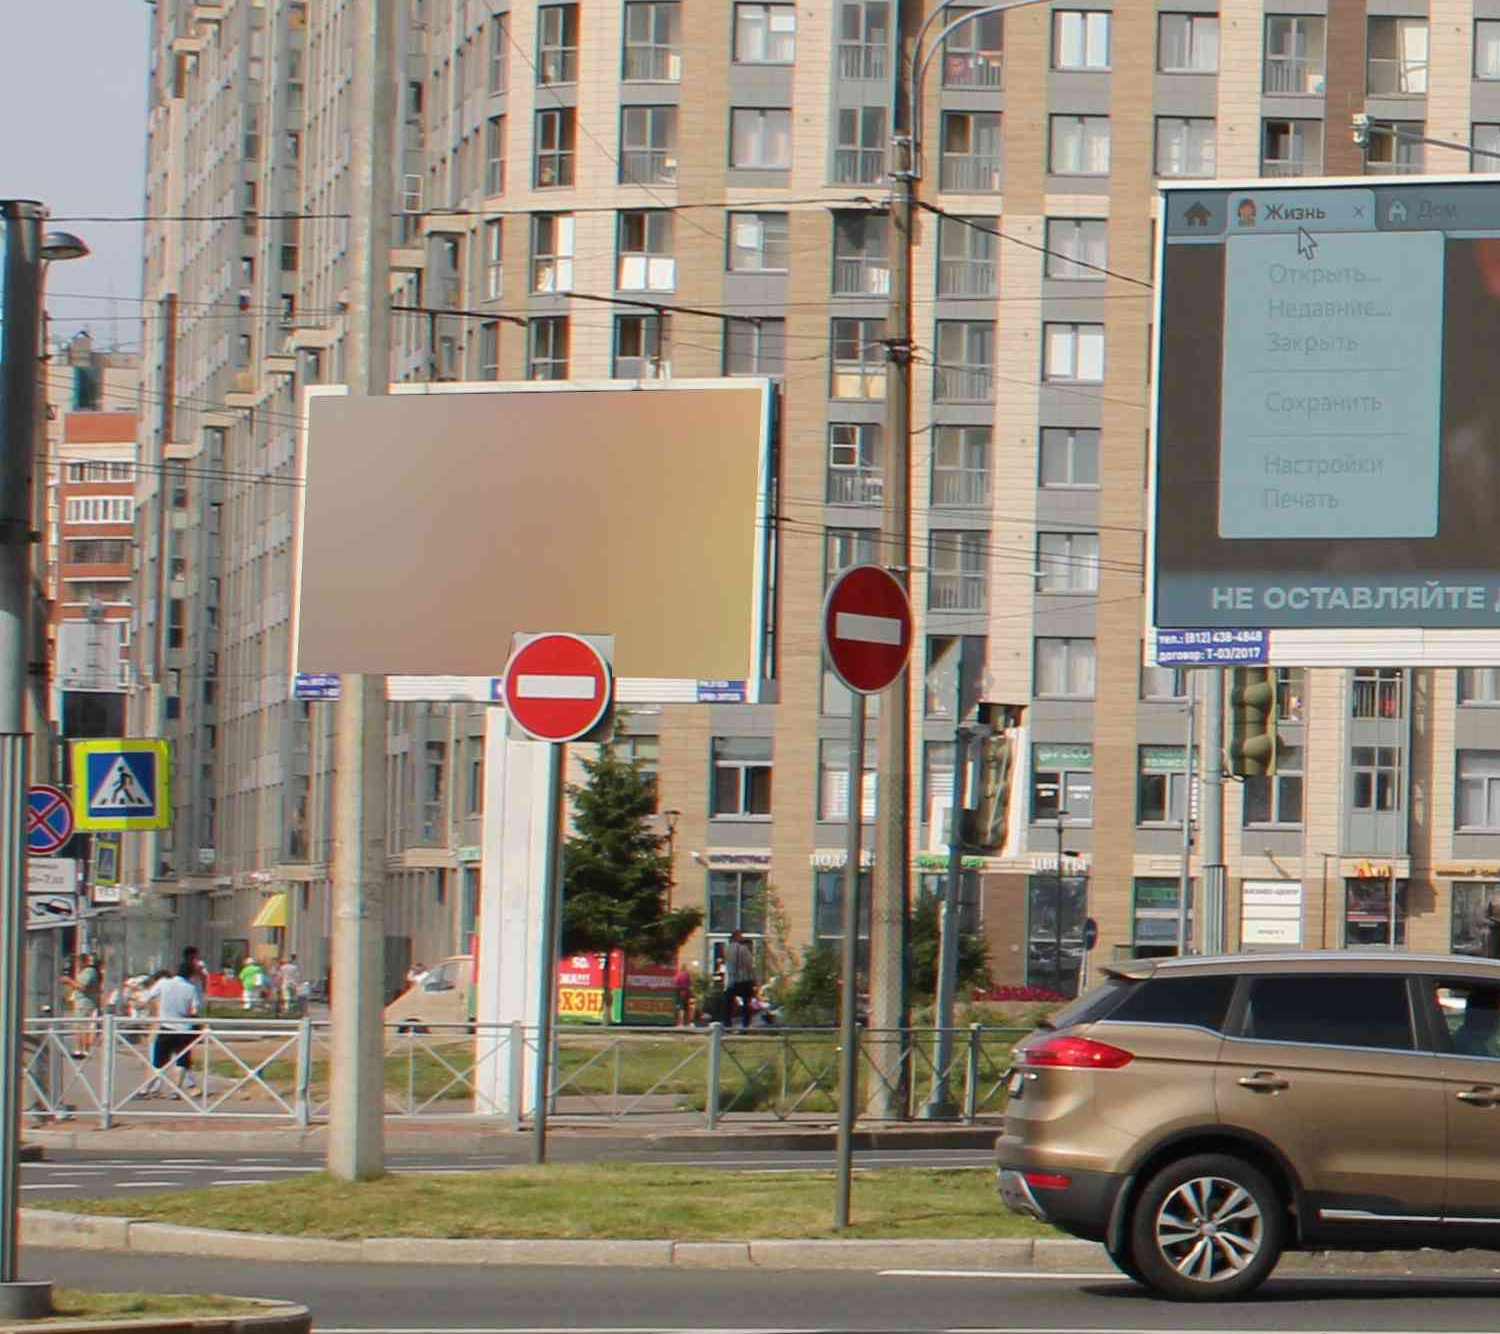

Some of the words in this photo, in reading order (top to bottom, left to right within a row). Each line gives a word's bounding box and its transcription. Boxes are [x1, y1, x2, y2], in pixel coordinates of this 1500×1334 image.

[1263, 203, 1327, 221] Жизнь
[1265, 332, 1359, 355] Закрыть
[1264, 392, 1383, 417] Сохранить
[1263, 453, 1384, 478] Настройки
[1263, 488, 1340, 509] Печать
[1210, 586, 1254, 610] НЕ
[1263, 580, 1486, 610] ОСТАВЛЯЙТЕ
